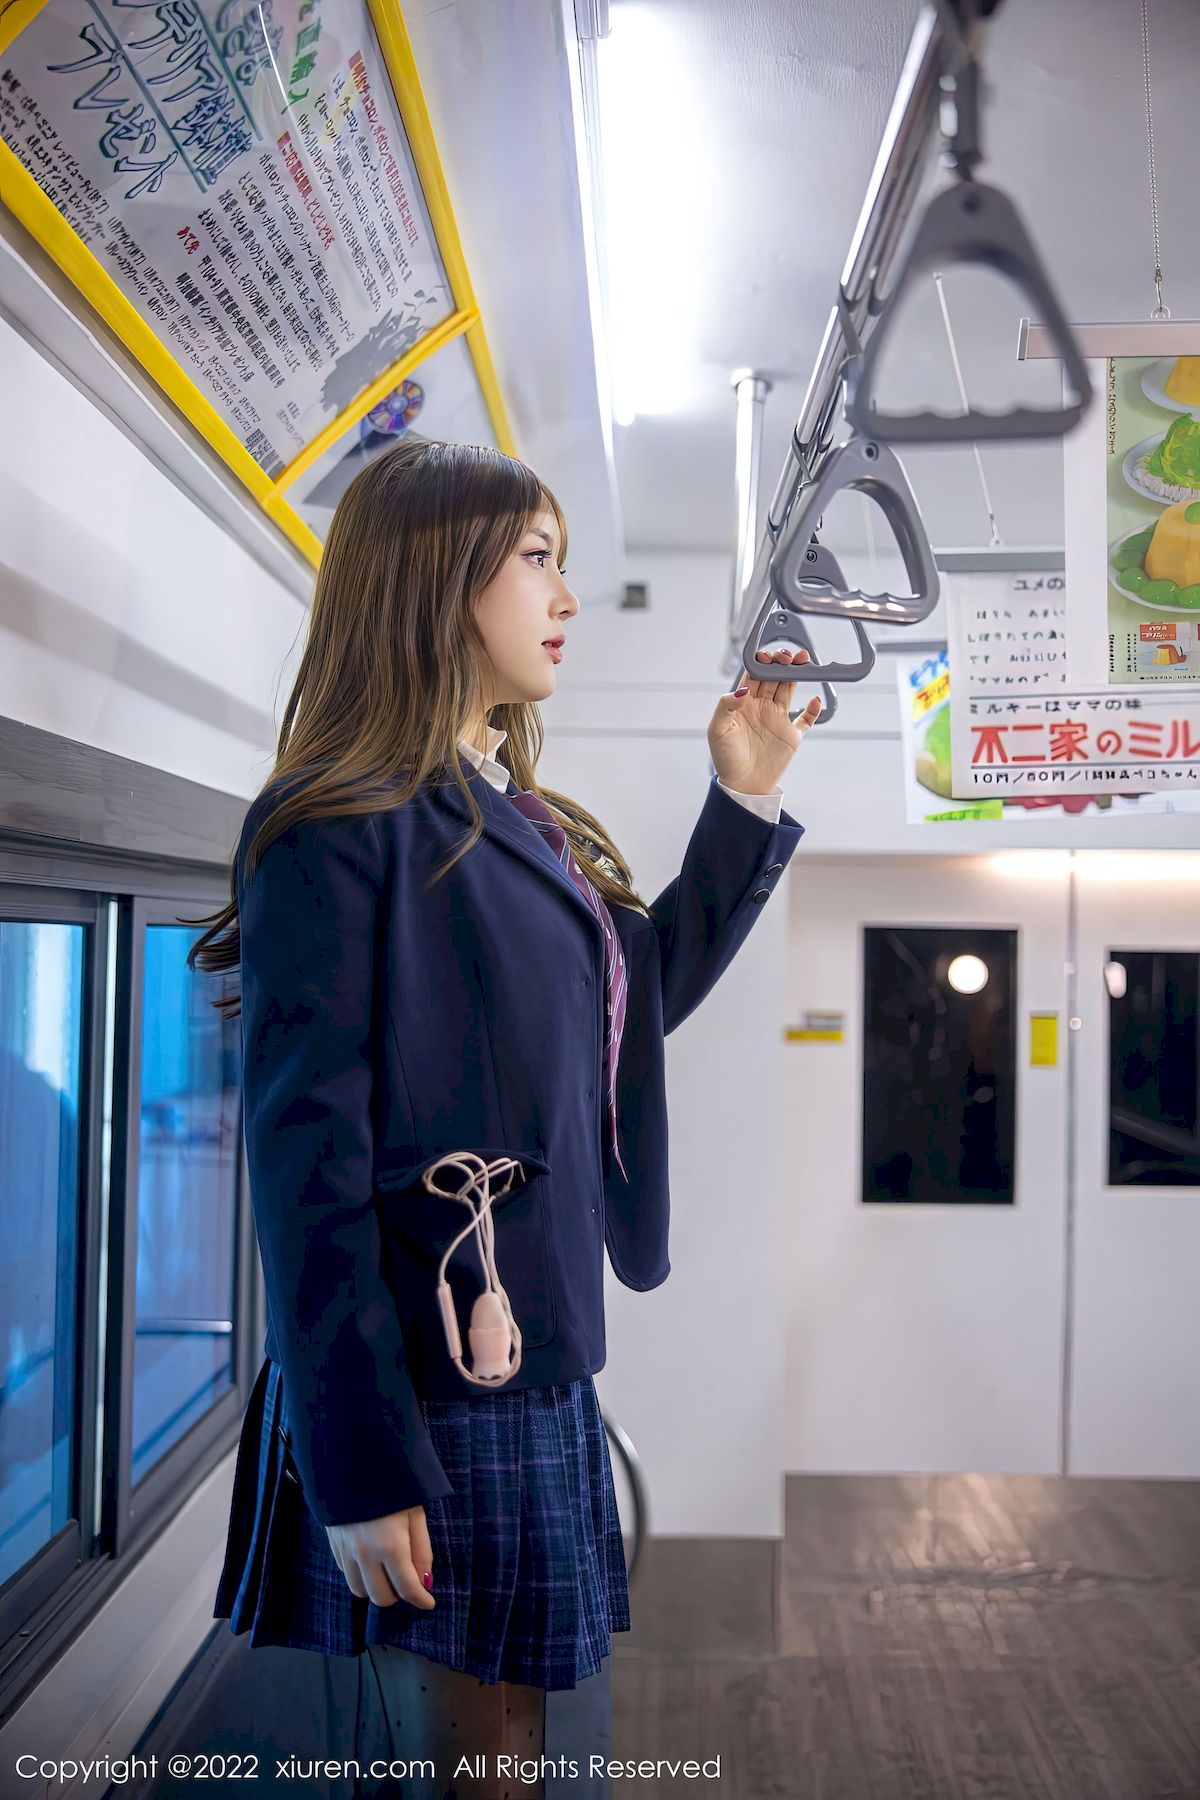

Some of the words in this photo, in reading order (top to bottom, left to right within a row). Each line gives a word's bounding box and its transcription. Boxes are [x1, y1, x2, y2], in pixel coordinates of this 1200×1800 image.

[112, 0, 253, 186] テリア鉢植
[971, 719, 1200, 763] 不二家のミル
